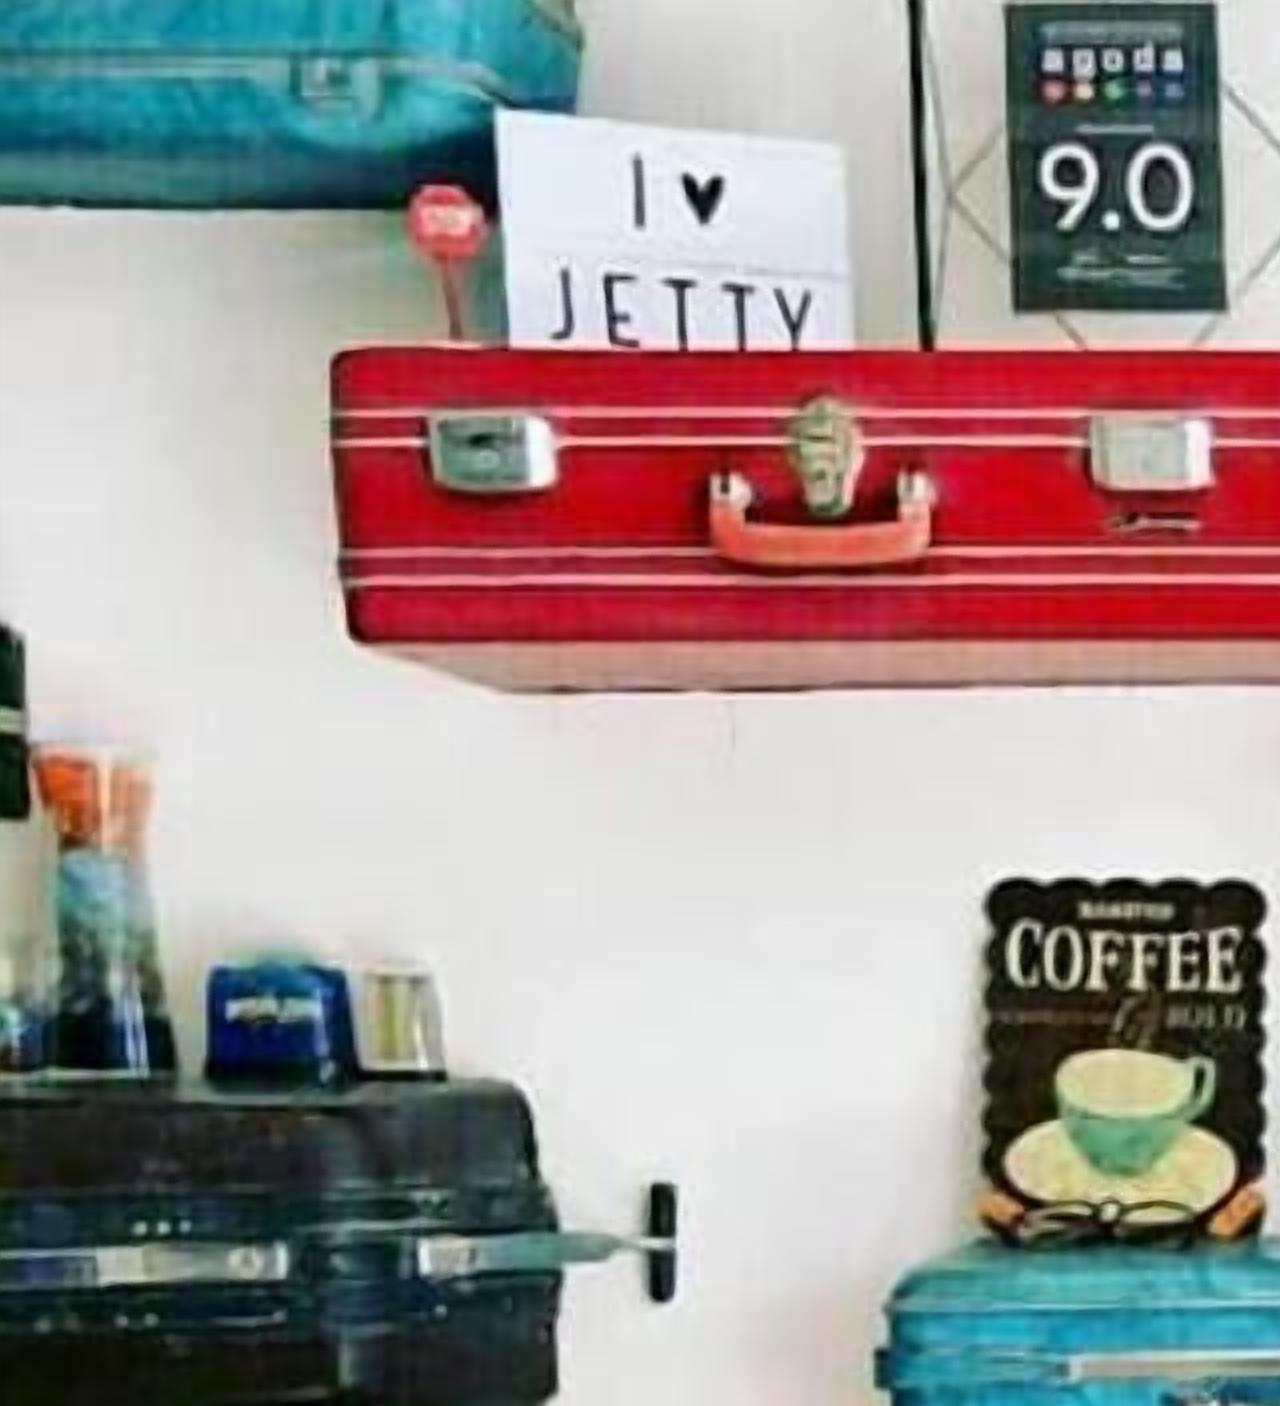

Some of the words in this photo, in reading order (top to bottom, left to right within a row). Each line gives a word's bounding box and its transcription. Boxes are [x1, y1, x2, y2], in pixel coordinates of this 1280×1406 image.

[632, 153, 645, 230] I
[1040, 143, 1192, 231] 9.0
[550, 268, 812, 351] JETTY
[1005, 917, 1244, 993] COFFEE
